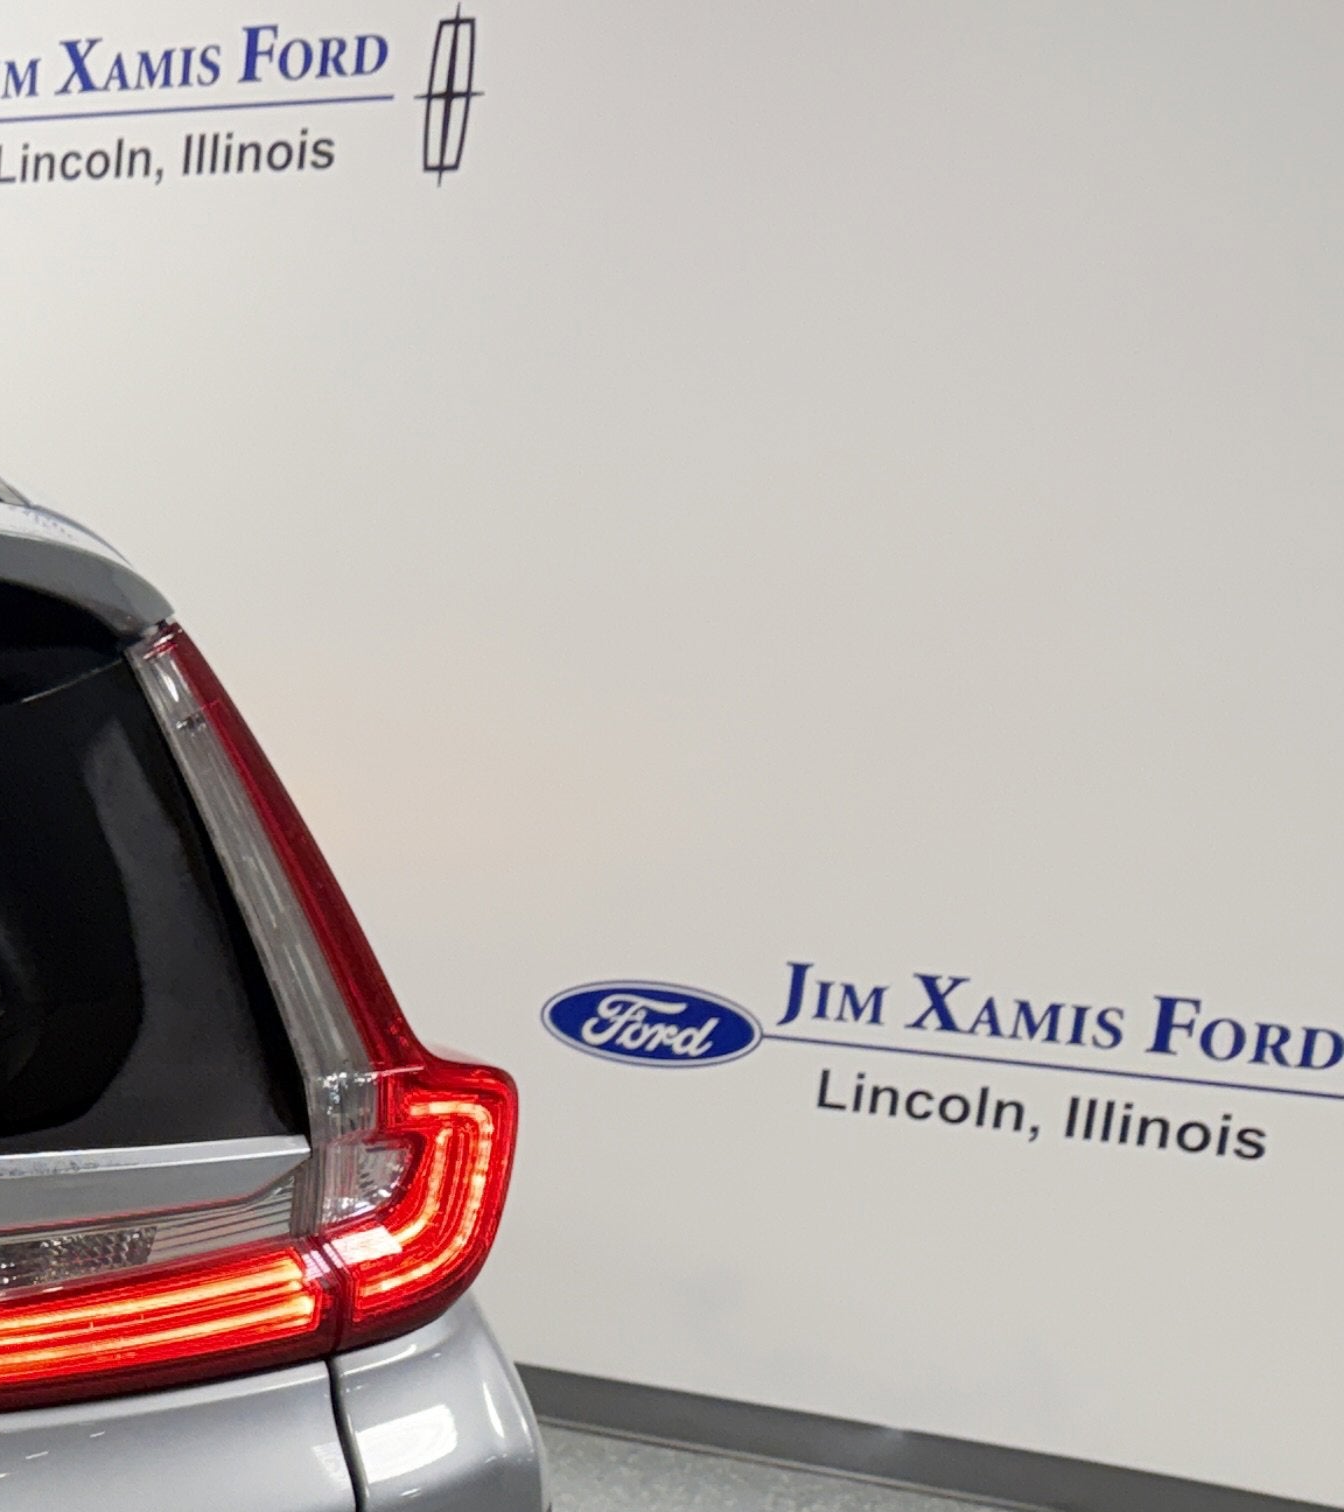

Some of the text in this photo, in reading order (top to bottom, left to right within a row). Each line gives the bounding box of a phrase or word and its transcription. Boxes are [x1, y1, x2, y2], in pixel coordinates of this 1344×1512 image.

[59, 37, 221, 97] XAMIS
[238, 24, 389, 84] FORD
[182, 129, 336, 177] Illinois
[581, 994, 716, 1059] Ford
[776, 961, 1344, 1070] JIM XAMIS FORD
[817, 1069, 1267, 1162] Lincoln, Illinois
